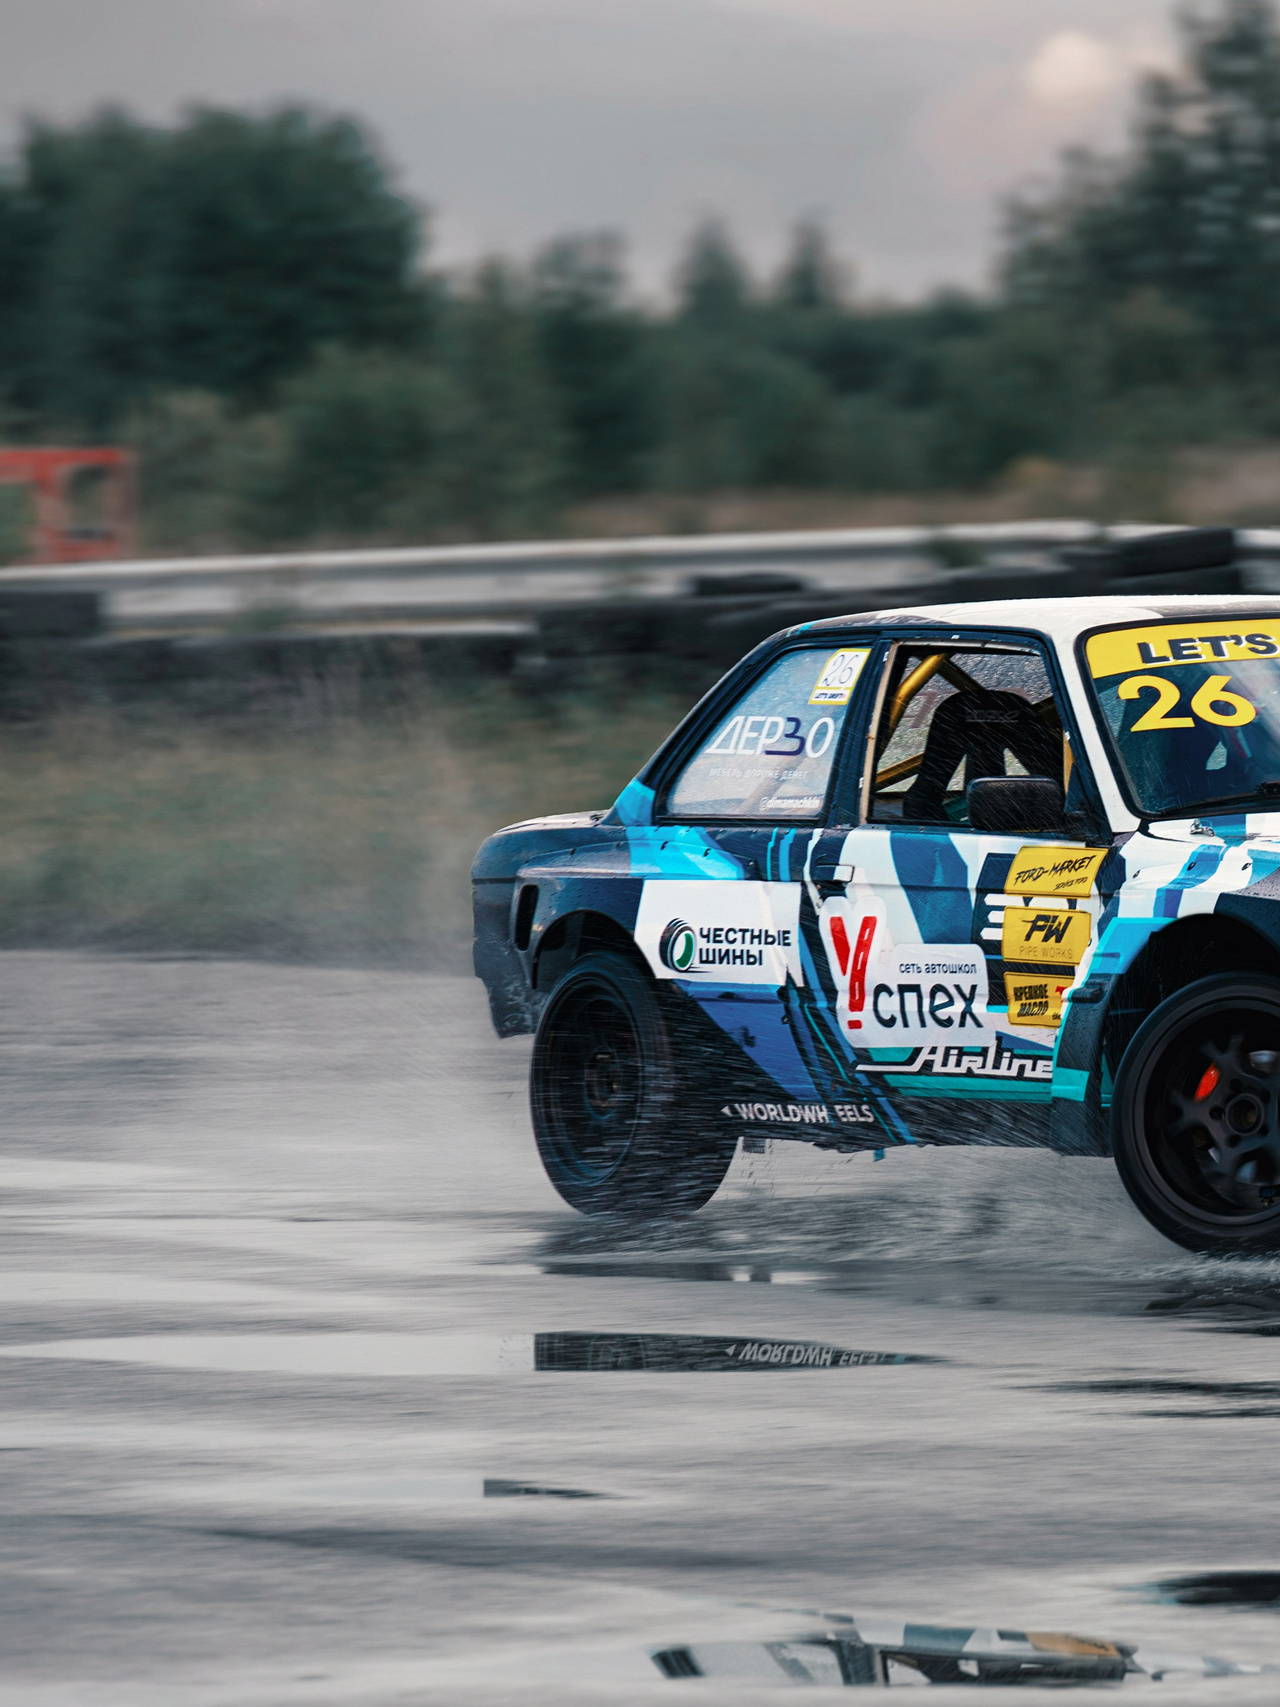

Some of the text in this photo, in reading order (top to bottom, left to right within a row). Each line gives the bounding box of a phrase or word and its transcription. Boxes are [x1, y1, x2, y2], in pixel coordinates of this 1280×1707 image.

[1137, 632, 1280, 666] LET'S
[822, 653, 860, 687] 26
[1117, 675, 1257, 733] 26
[703, 715, 835, 759] ДЕРЗО
[699, 927, 792, 947] ЧЕСТНЫЕ
[698, 948, 764, 966] ШИНЫ
[1019, 945, 1074, 960] PIPE WORKS
[899, 962, 977, 975] сеть автошкол
